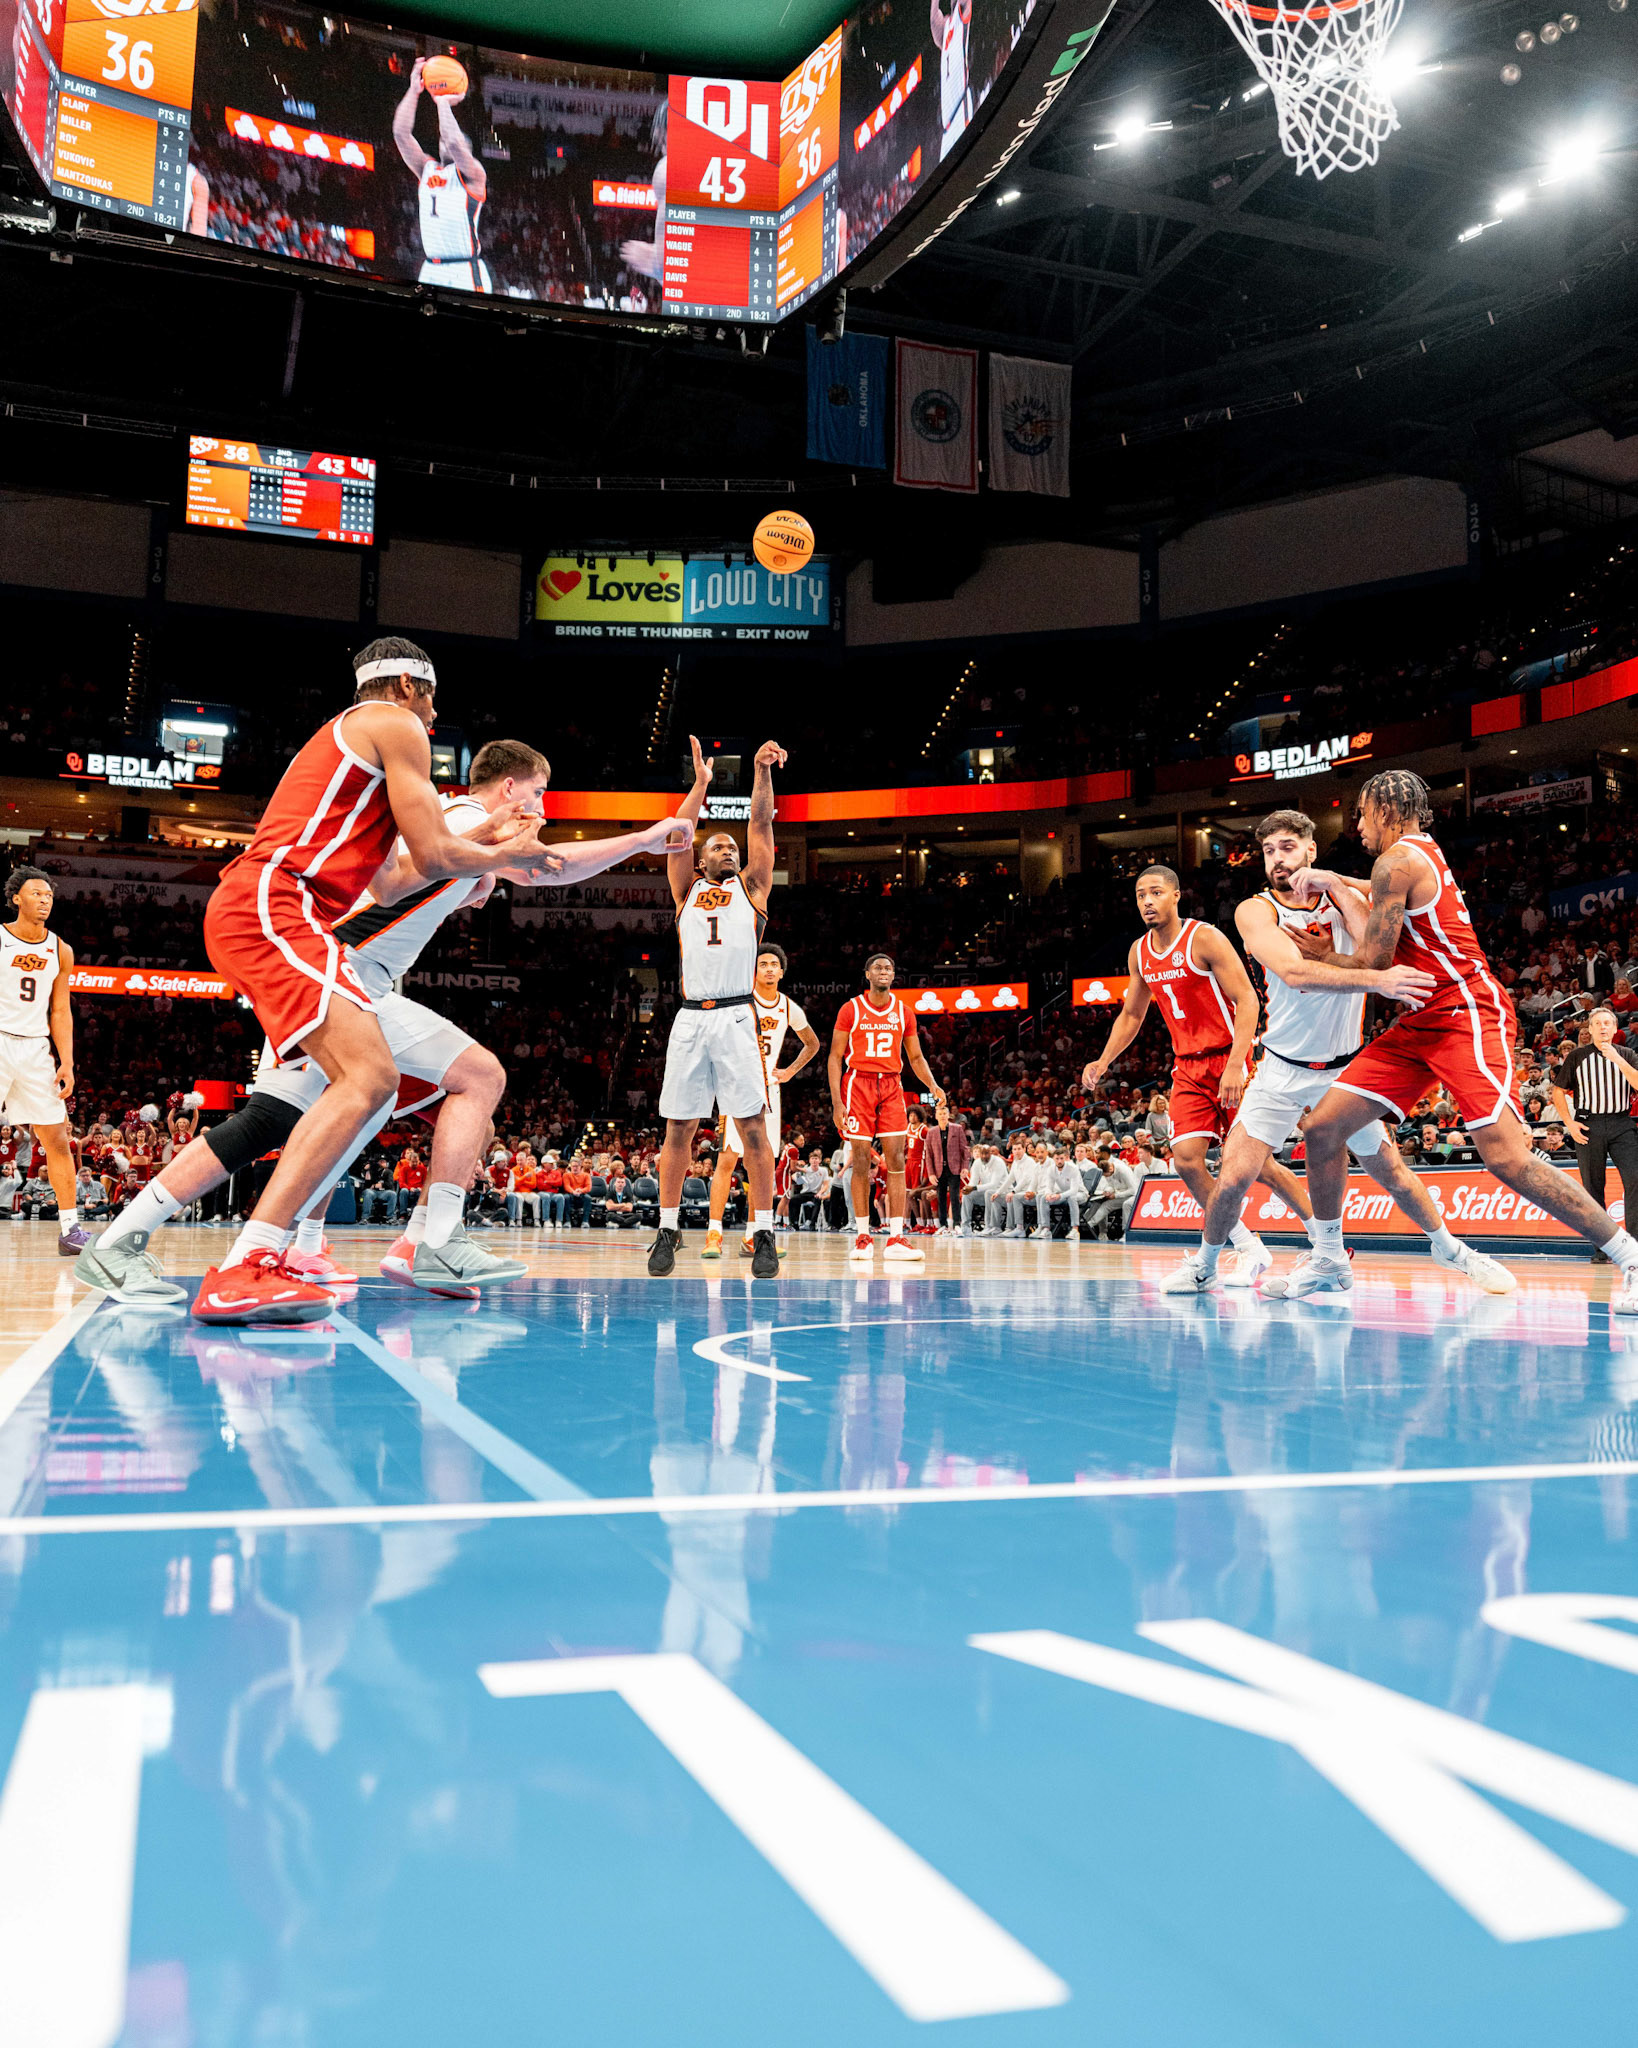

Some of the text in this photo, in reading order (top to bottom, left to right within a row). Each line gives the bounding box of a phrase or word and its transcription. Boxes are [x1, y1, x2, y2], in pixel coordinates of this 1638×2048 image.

[102, 29, 155, 90] 36
[64, 79, 188, 125] PLAYER PTS FL
[61, 96, 184, 141] CLARY 5 2
[60, 114, 183, 157] MILLER 7 1
[59, 131, 182, 174] ROY 13 0
[796, 127, 822, 189] 36
[58, 148, 180, 192] VUKOVIC 4 0
[699, 156, 747, 204] 43
[56, 166, 179, 209] MANTZOUKAS 2 1
[61, 185, 177, 226] TO 3 TF 0 2ND 18:21
[668, 209, 776, 226] PLAYER PTS FL
[666, 225, 695, 236] BROWN
[755, 232, 760, 241] 7
[666, 240, 693, 252] WAGUE
[754, 247, 760, 256] 4
[665, 256, 689, 267] JONES
[665, 272, 687, 283] DAVIS
[753, 279, 759, 288] 2
[664, 288, 683, 298] REID
[670, 304, 770, 320] TO 3 TF 1 2ND 18:21
[859, 370, 868, 428] OKLAHOMA
[223, 444, 250, 462] 36
[269, 455, 298, 468] 18:21
[318, 457, 345, 475] 43
[767, 530, 805, 550] Wilson
[690, 569, 823, 616] LOUD CITY
[555, 625, 810, 640] BRING THE THUNDER EXIT NOW
[1253, 734, 1350, 773] BEDLAM
[87, 753, 196, 783] BEDLAM
[1274, 761, 1333, 781] BASKETBALL
[108, 776, 174, 790] BASKETBALL
[1543, 788, 1578, 802] PAINT
[536, 886, 566, 902] POST
[584, 887, 609, 901] OAK
[614, 888, 656, 901] PARTY
[693, 887, 733, 911] OSU
[706, 916, 722, 946] 1
[10, 953, 48, 972] OSU
[1144, 967, 1188, 984] OKLAHOMA
[20, 976, 37, 1003] 9
[1162, 983, 1187, 1020] 1
[859, 1023, 899, 1031] OKLAHOMA
[865, 1032, 894, 1058] 12
